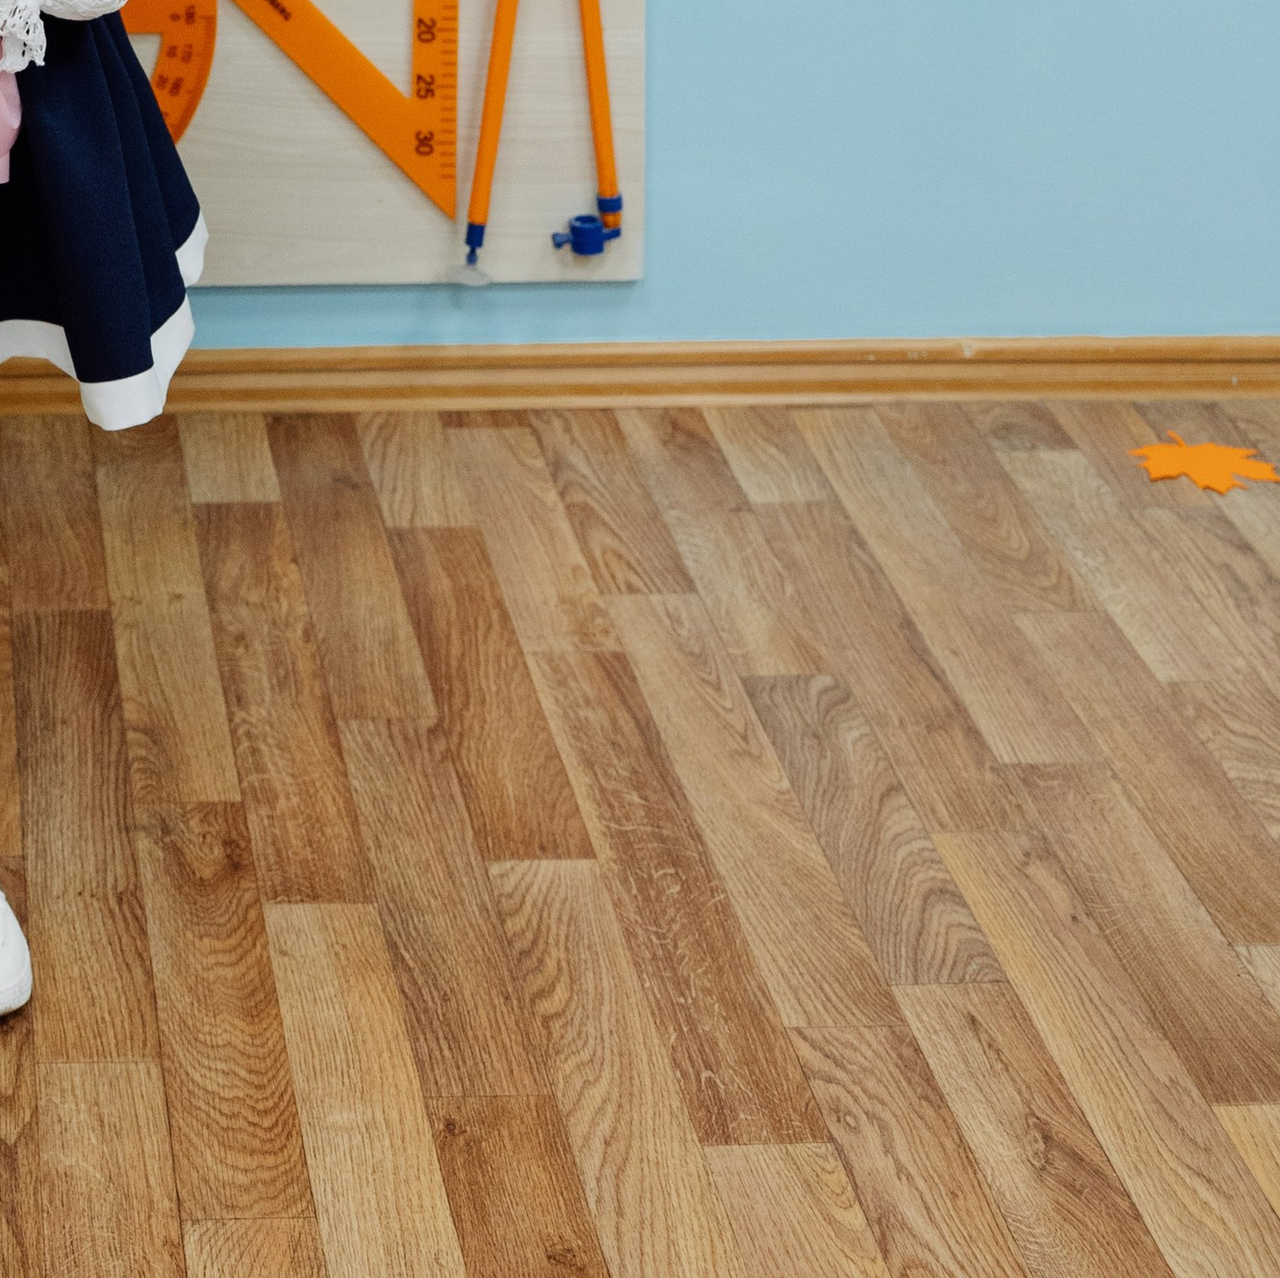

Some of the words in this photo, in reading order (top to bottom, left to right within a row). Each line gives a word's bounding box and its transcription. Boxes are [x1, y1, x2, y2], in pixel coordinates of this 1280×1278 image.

[416, 17, 437, 44] 20
[415, 74, 436, 100] 25
[414, 131, 435, 156] 30
